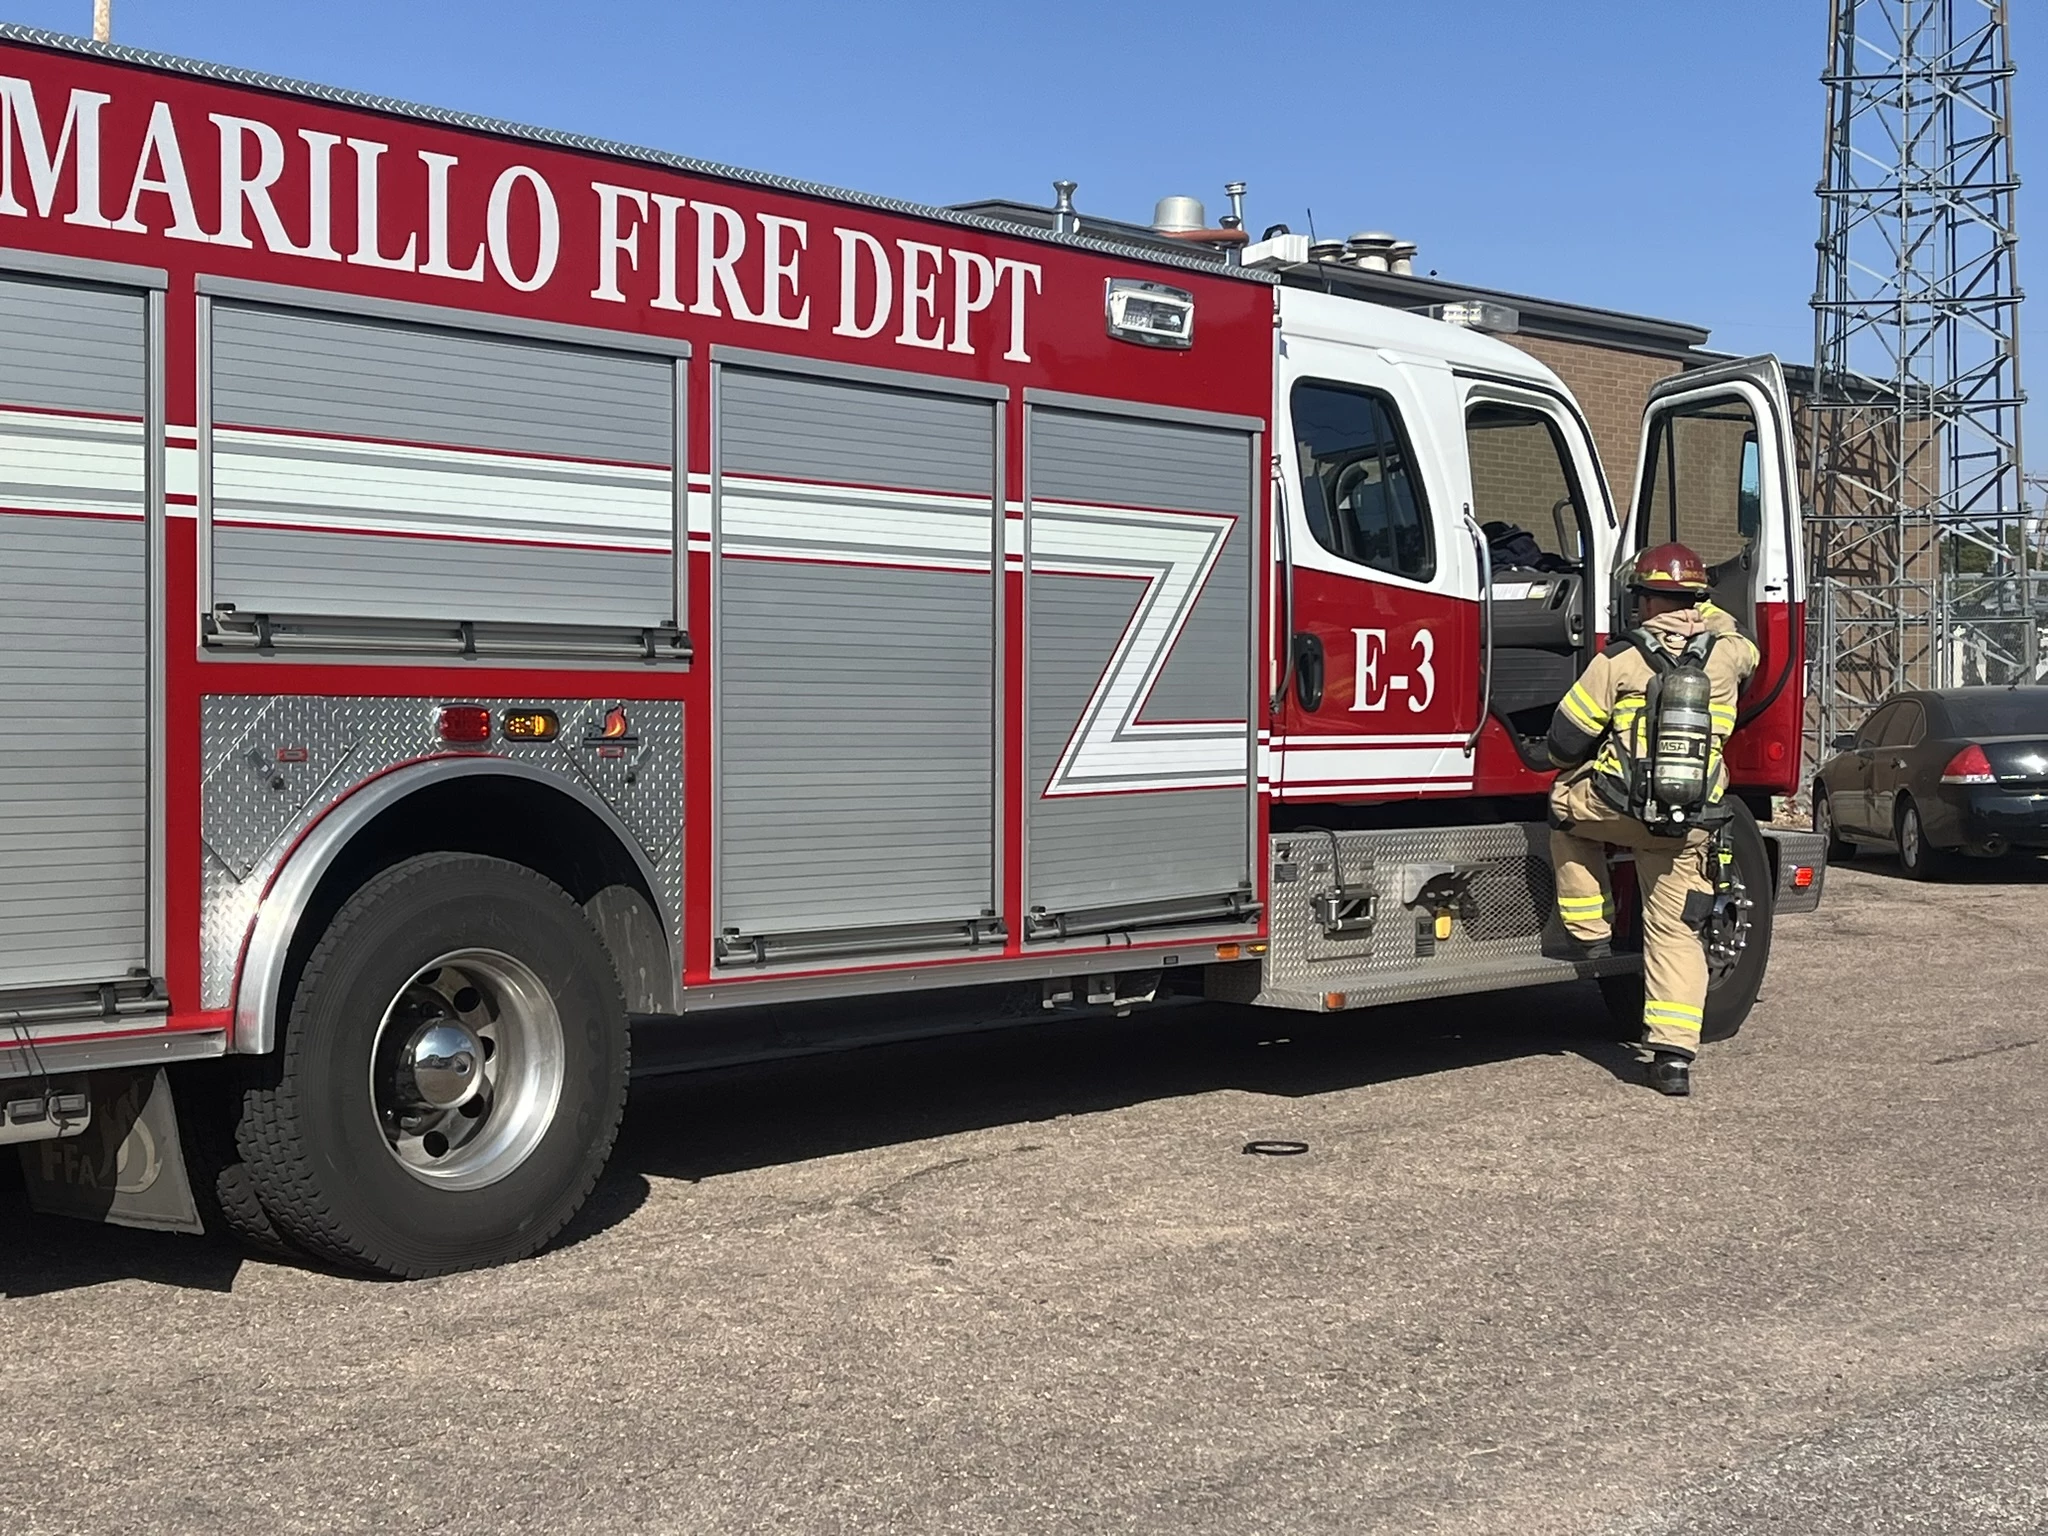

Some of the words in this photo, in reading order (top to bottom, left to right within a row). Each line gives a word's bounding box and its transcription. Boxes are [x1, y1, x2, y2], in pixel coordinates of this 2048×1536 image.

[0, 76, 560, 292] MARILLO
[590, 181, 810, 331] FIRE
[832, 226, 1042, 363] DEPT
[1348, 628, 1436, 713] E-3
[1659, 741, 1687, 752] MSA
